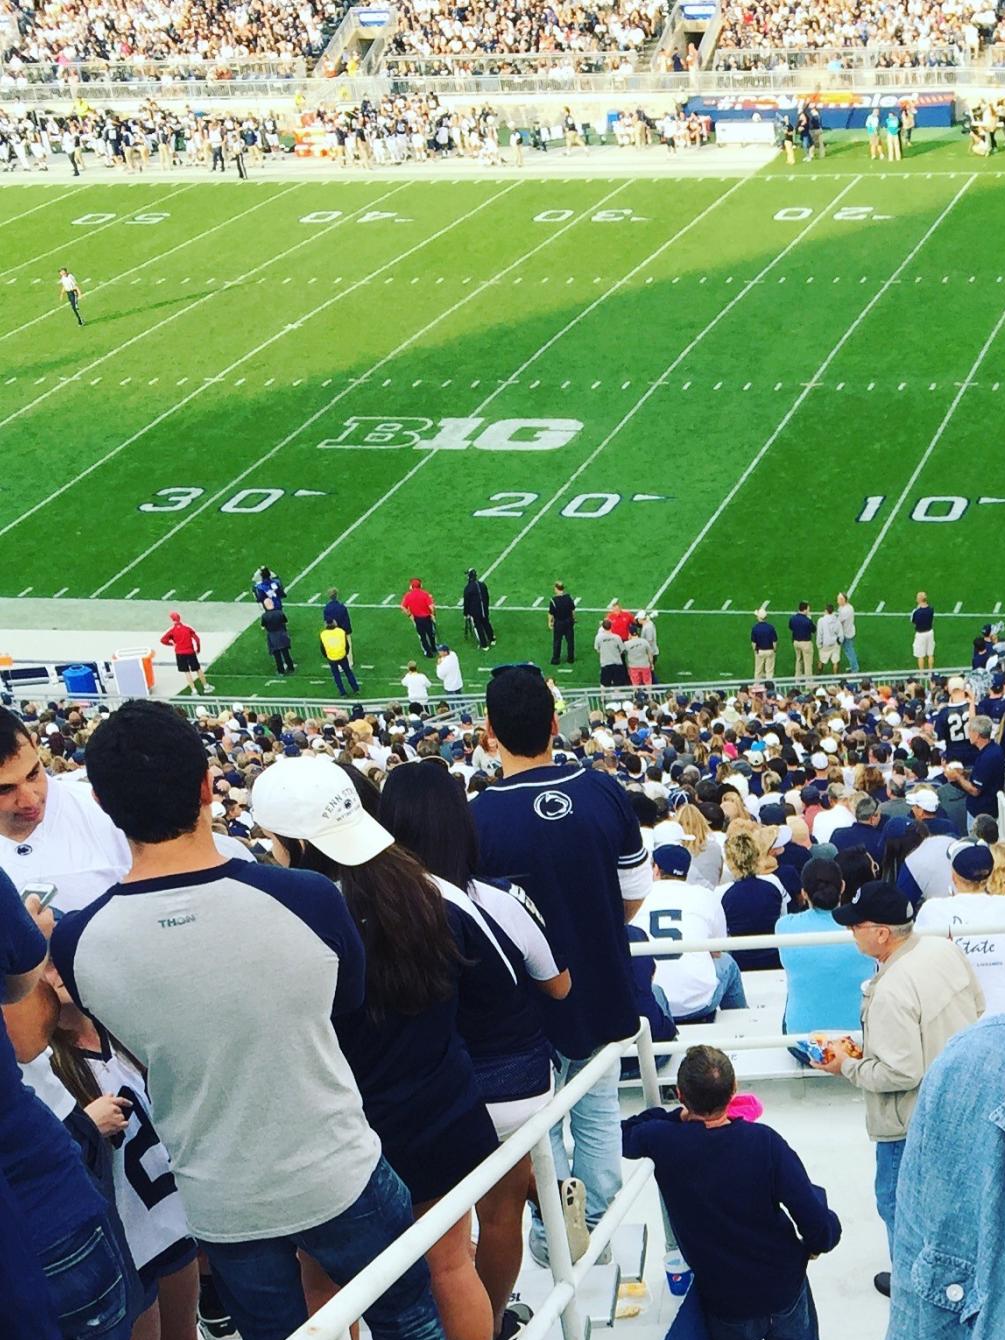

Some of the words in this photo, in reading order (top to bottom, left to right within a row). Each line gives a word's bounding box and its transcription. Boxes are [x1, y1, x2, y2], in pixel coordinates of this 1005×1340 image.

[72, 212, 171, 226] 50
[299, 210, 398, 223] 40
[533, 208, 636, 222] 30
[774, 206, 875, 221] 20
[138, 486, 286, 513] 30
[471, 491, 624, 519] 20
[856, 495, 970, 522] 10
[649, 909, 683, 961] 5
